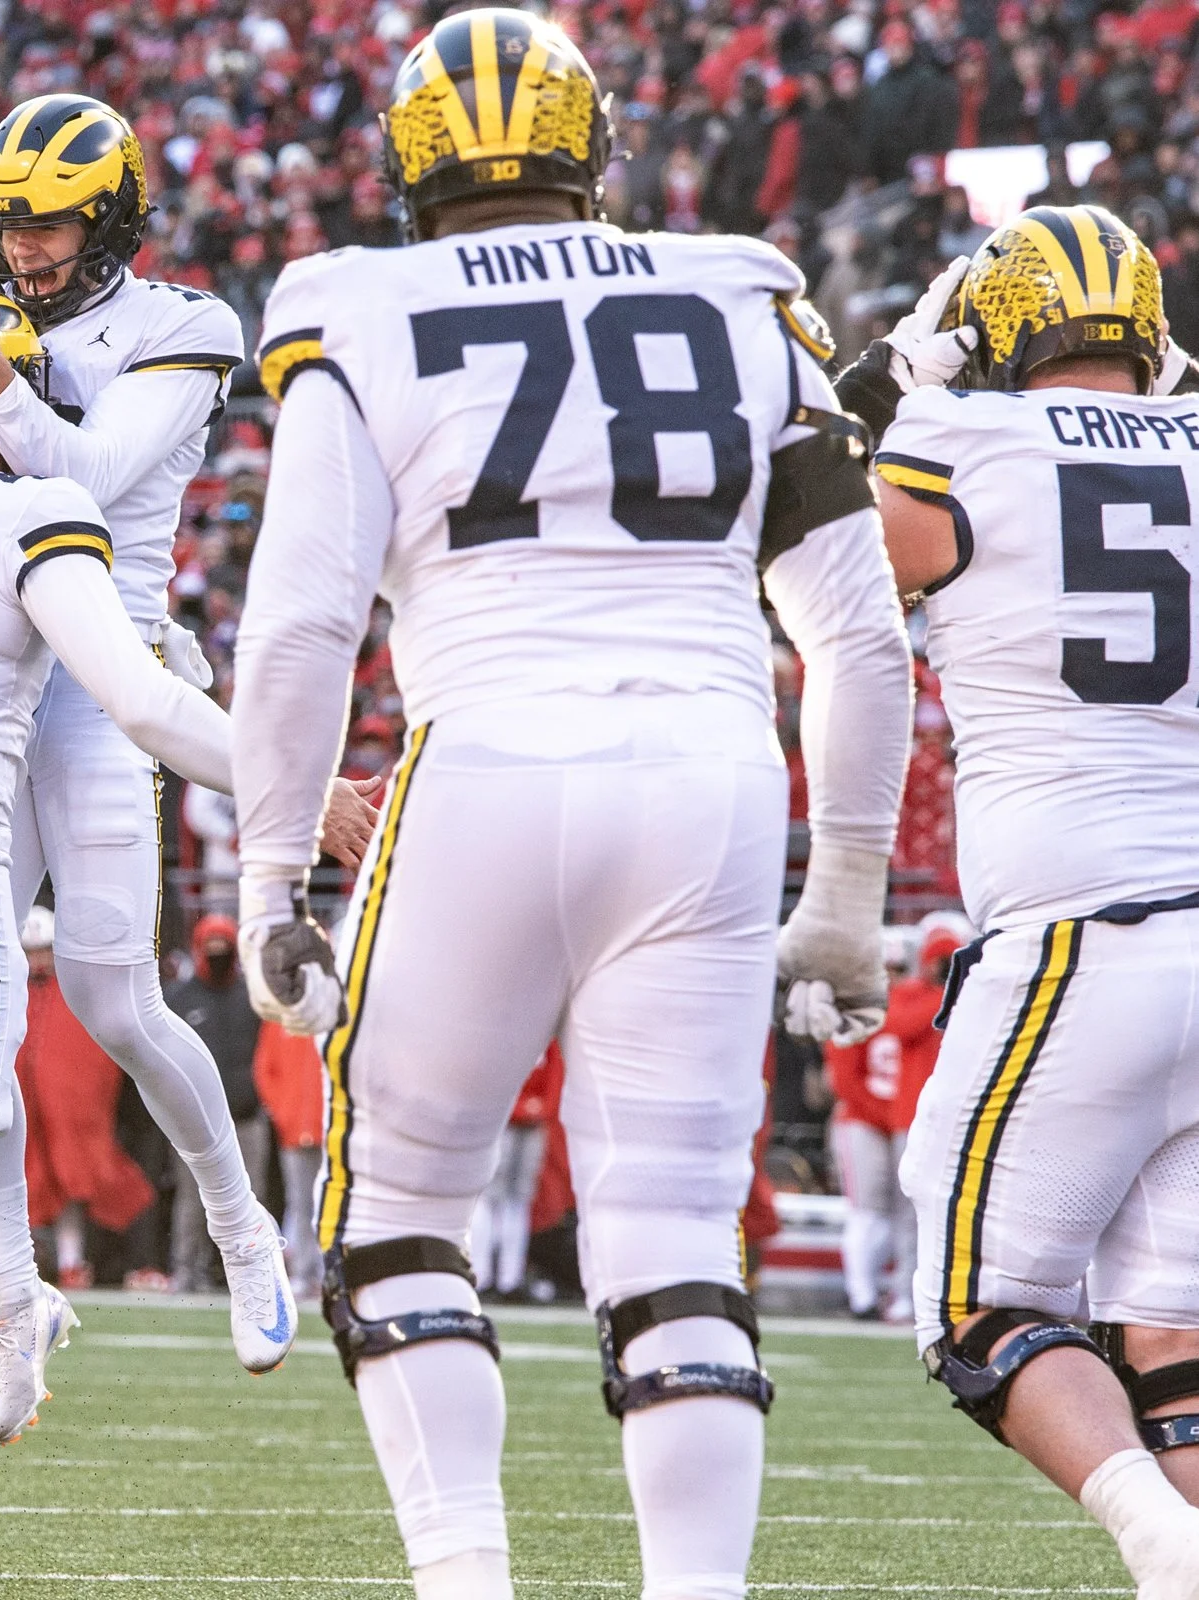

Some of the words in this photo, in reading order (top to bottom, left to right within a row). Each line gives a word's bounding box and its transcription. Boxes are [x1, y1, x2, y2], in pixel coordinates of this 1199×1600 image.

[455, 236, 657, 287] HINTON
[409, 292, 753, 552] 78
[1056, 462, 1199, 705] 5
